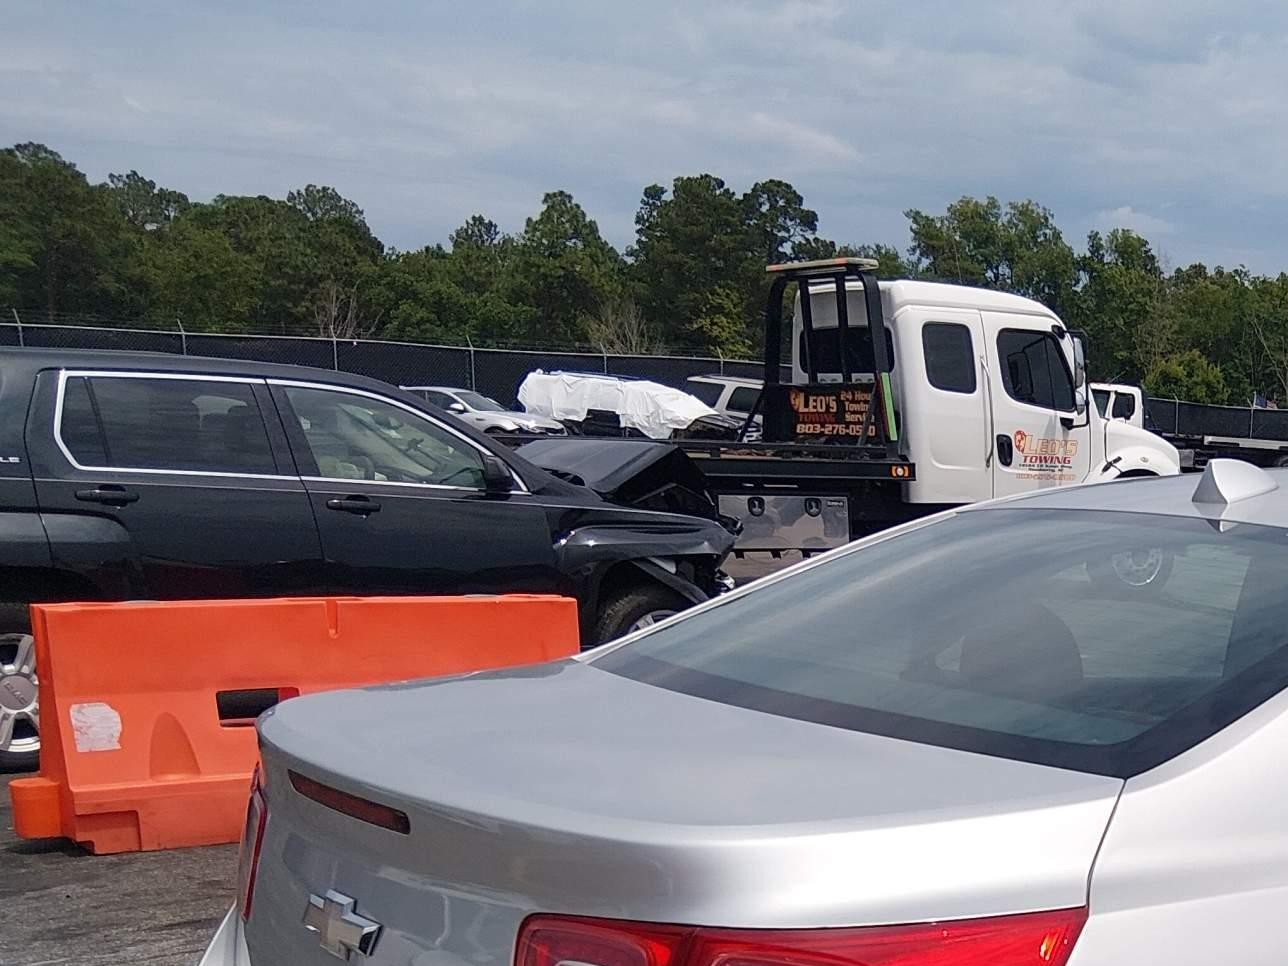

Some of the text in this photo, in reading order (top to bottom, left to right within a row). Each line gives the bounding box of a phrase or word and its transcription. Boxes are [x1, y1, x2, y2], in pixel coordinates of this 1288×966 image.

[840, 391, 872, 401] 24 Hou
[799, 392, 837, 412] LEO'S
[844, 402, 870, 411] Towin
[796, 424, 876, 436] 803-276-050
[1023, 435, 1078, 456] LEO'S
[1023, 456, 1071, 464] TOWING
